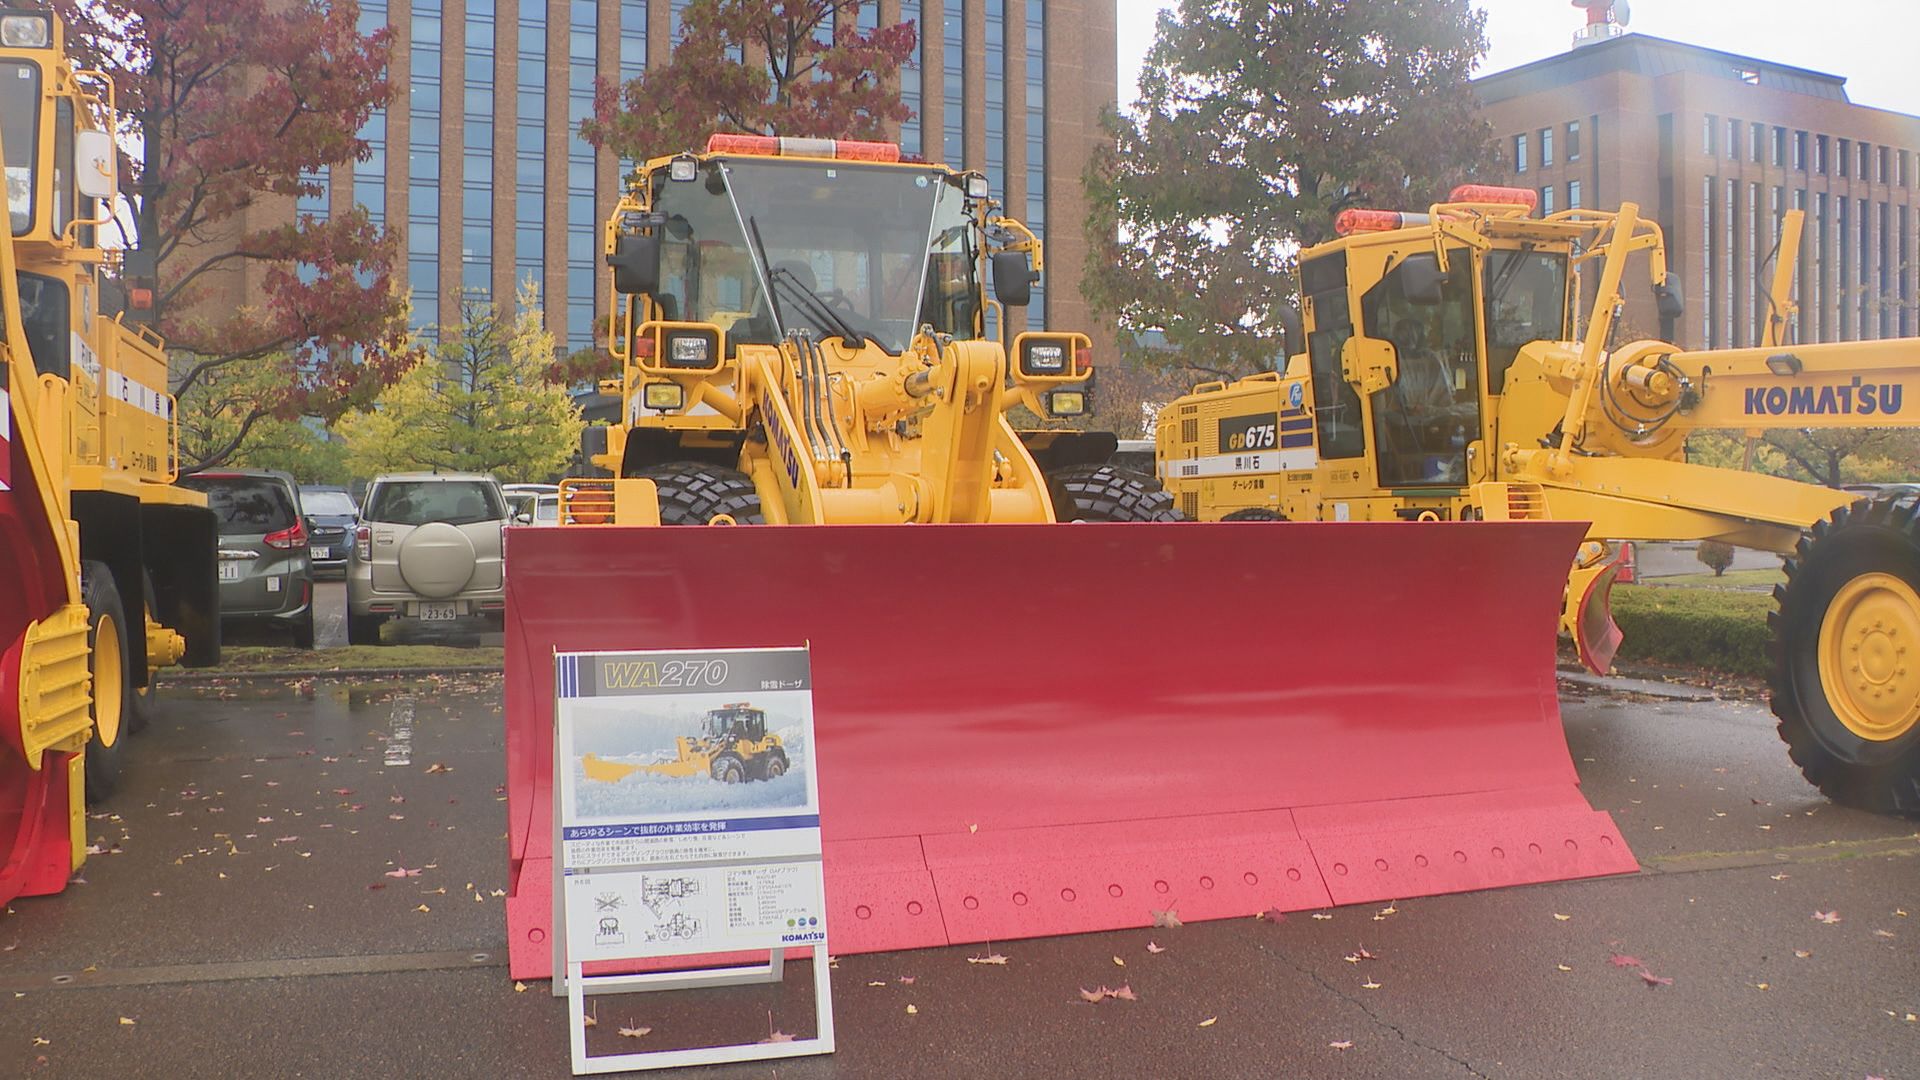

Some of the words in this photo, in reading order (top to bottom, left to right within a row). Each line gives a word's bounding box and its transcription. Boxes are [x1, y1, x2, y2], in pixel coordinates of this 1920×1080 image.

[1744, 376, 1903, 415] KOMATSU
[1229, 425, 1275, 450] GD675
[604, 660, 729, 688] WA270
[569, 821, 727, 839] あらゆるシーンで抜群の作業効率を発揮
[781, 932, 825, 942] KOMATSU
